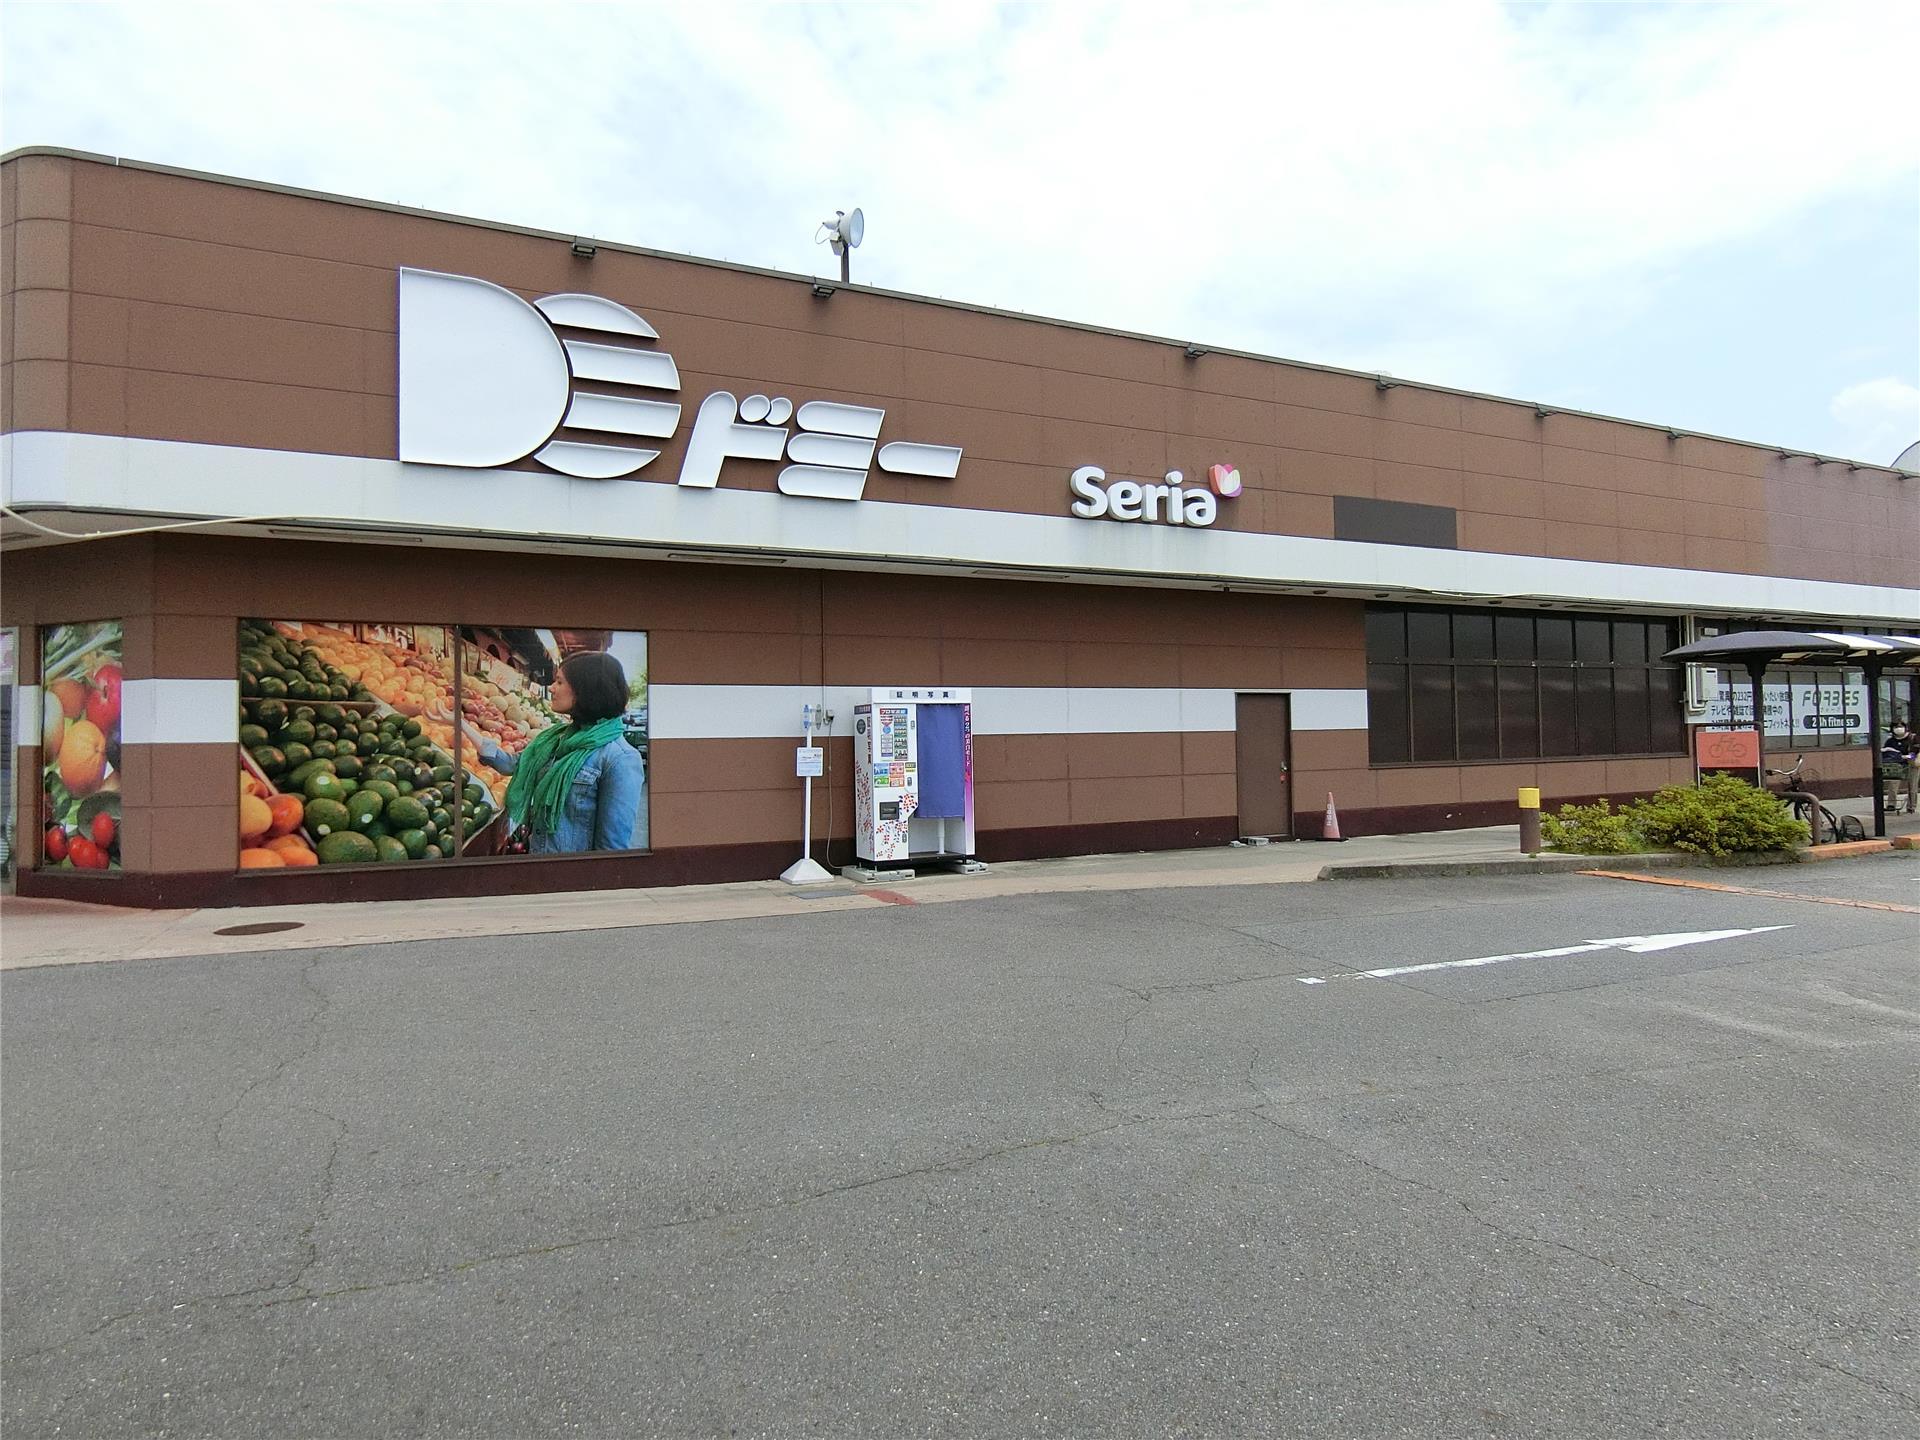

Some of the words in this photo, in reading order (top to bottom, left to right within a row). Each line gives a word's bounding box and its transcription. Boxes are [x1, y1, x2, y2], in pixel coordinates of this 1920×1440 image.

[679, 391, 963, 500] ドミー
[1070, 466, 1217, 527] Seria
